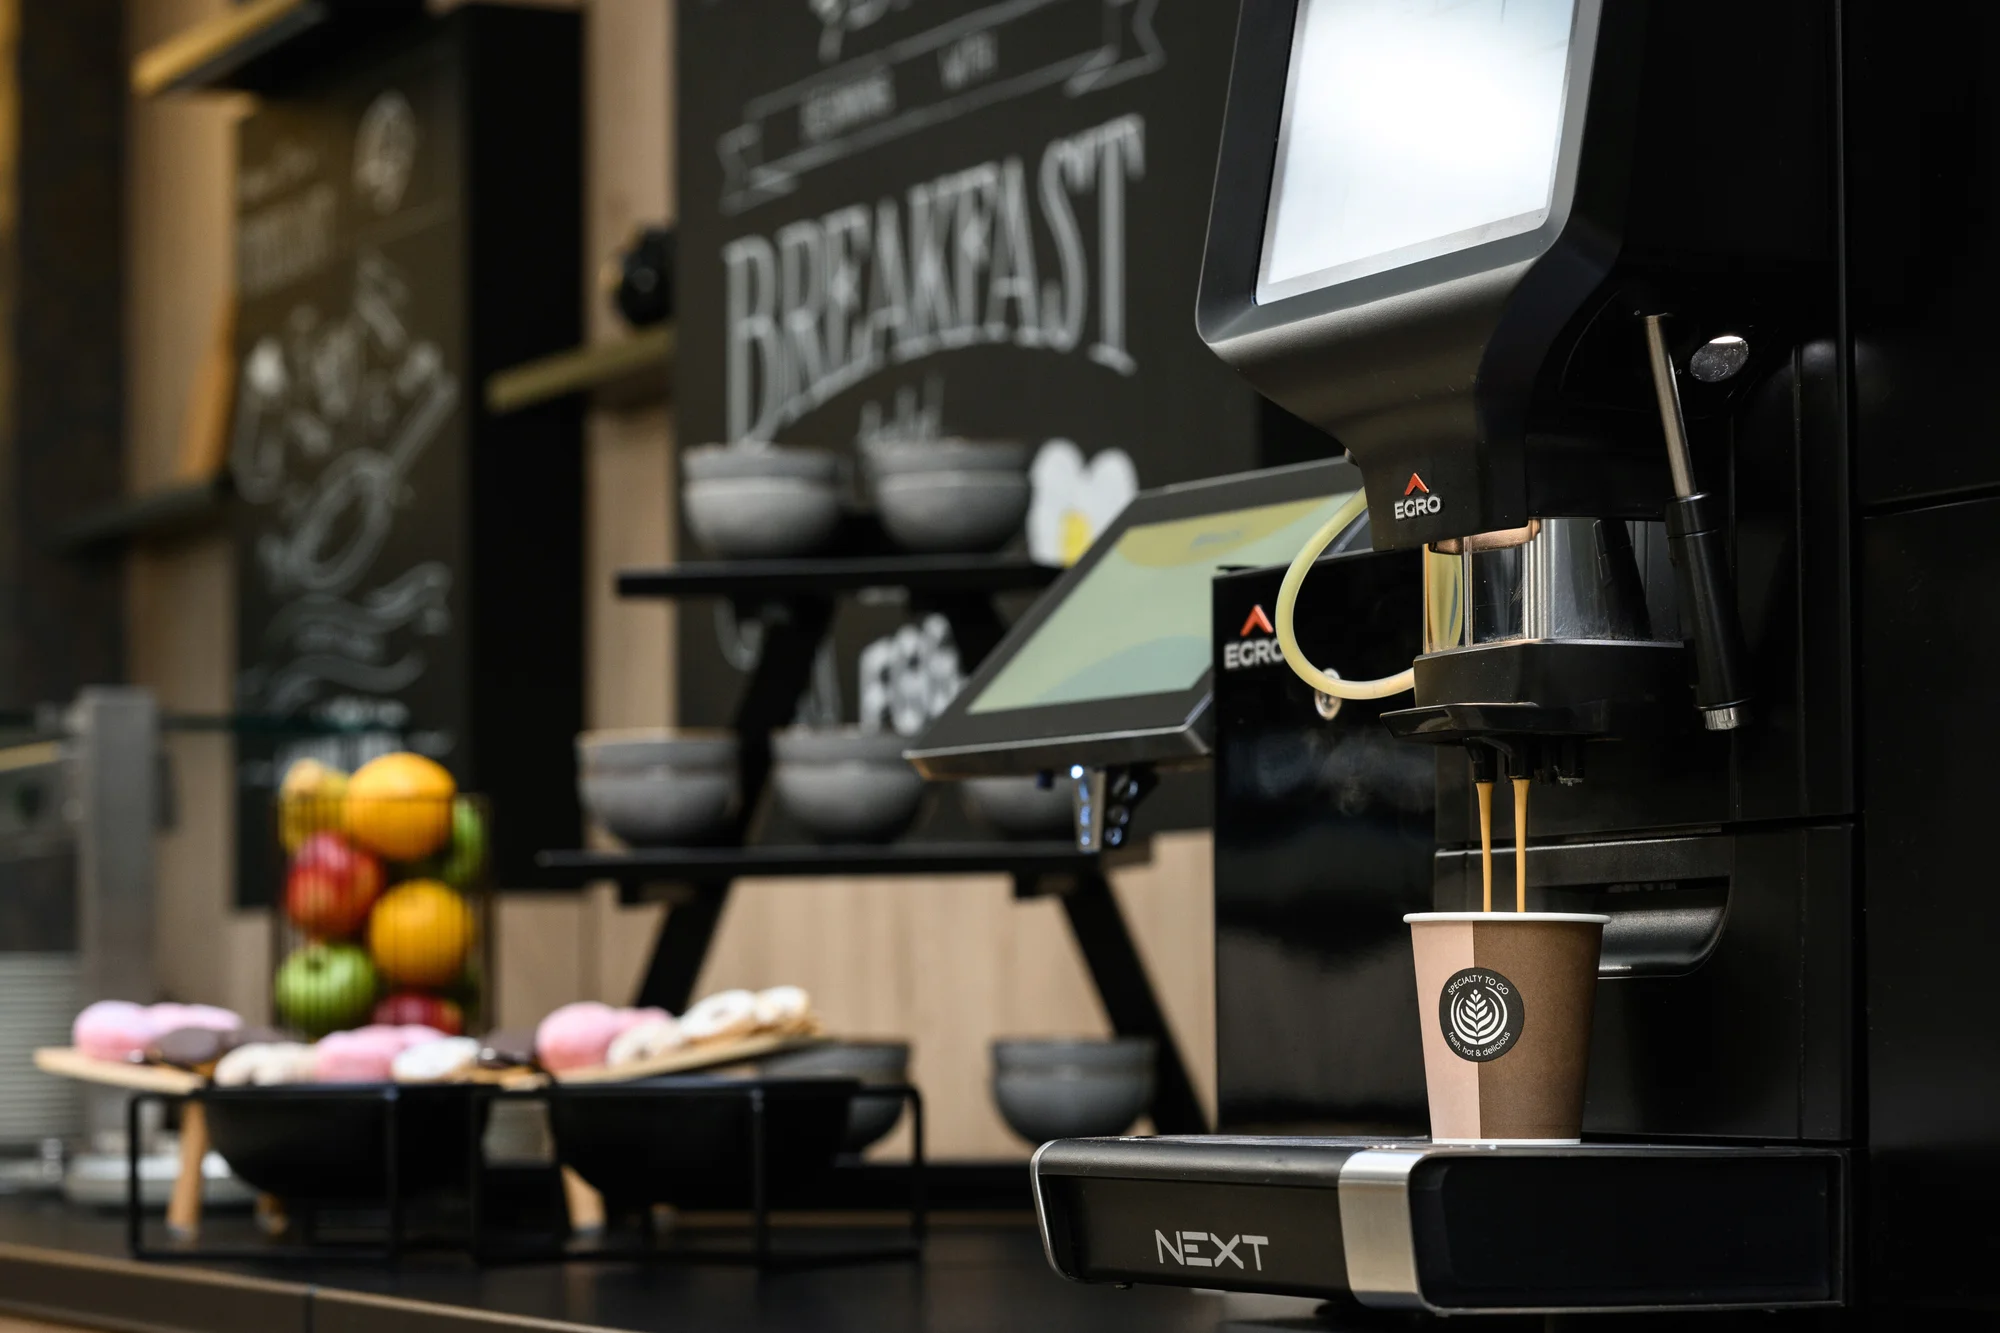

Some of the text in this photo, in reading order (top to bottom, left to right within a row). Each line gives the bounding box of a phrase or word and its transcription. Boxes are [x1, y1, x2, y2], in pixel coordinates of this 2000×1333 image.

[721, 112, 1146, 448] BREAKFAST
[1394, 496, 1441, 520] EGRO
[1448, 974, 1509, 995] SPECIALTY TO GO
[1448, 1031, 1511, 1057] fresh, hot & delicious
[1155, 1229, 1269, 1271] NEXT
